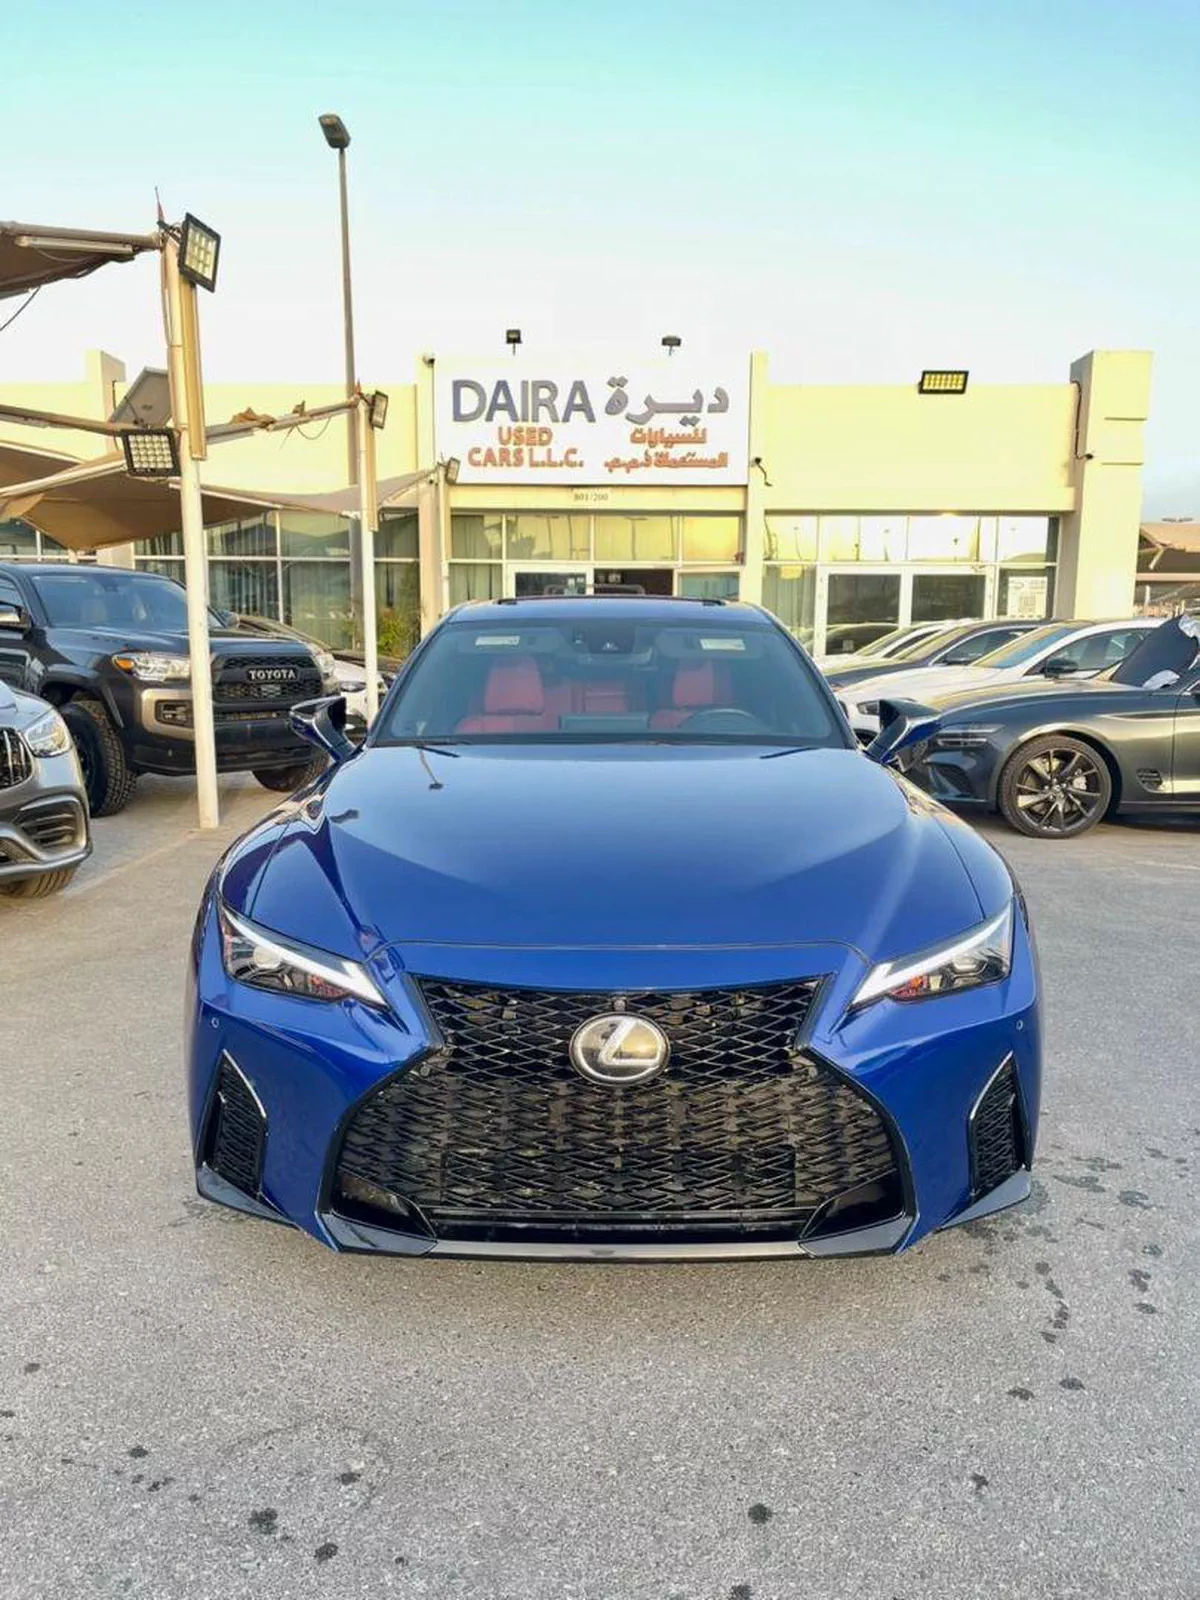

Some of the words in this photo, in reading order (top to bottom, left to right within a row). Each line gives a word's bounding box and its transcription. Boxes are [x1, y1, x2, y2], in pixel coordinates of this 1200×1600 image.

[452, 379, 596, 422] DAIRA
[604, 376, 729, 426] ديرة
[498, 426, 553, 446] USED
[630, 427, 707, 448] للسيارات
[467, 447, 524, 468] CARS
[528, 447, 584, 468] L.L.C.
[249, 669, 297, 680] TOYOTA
